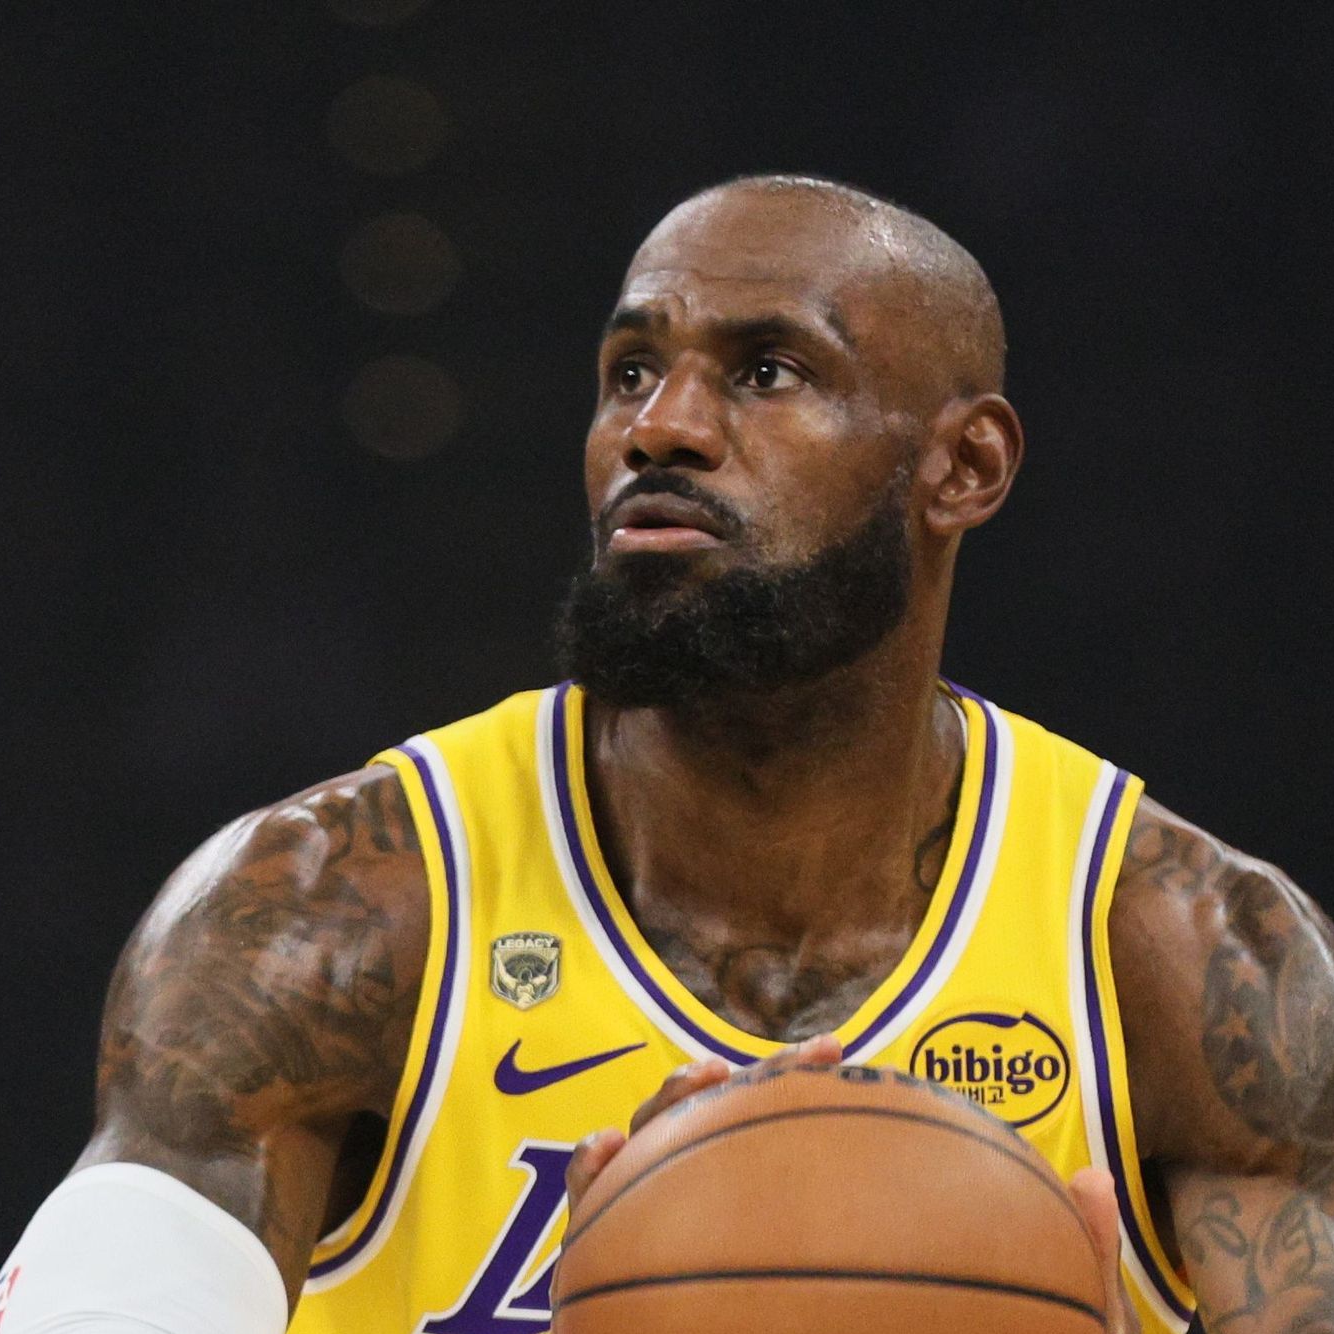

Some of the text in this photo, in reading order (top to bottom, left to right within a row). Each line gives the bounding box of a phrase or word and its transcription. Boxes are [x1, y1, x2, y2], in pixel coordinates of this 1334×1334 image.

[498, 937, 554, 949] LEGACY
[925, 1044, 1060, 1094] bibigo
[951, 1086, 1006, 1105] 비고
